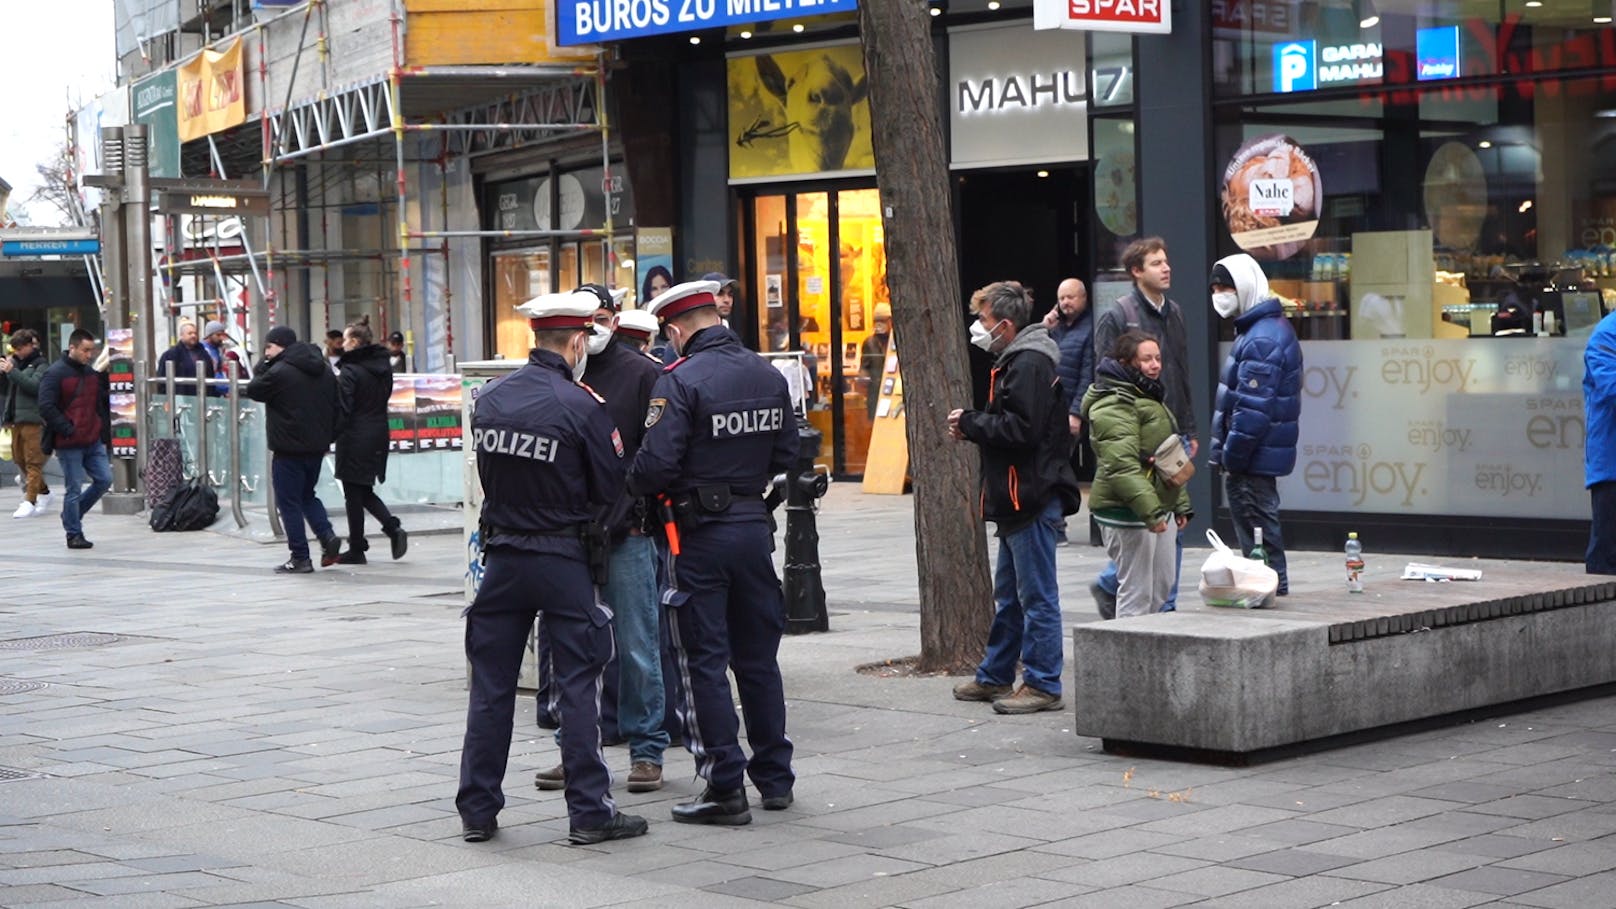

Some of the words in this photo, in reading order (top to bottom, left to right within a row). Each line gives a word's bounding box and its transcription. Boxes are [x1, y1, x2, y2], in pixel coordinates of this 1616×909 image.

[678, 0, 715, 22] ZU
[1071, 0, 1158, 17] SPAR
[1321, 43, 1383, 62] GARA
[1381, 358, 1479, 394] enjoy.
[711, 407, 783, 438] POLIZEI
[472, 427, 559, 462] POLIZEI
[1302, 444, 1354, 457] SPAR
[1408, 427, 1473, 452] enjoy.
[1303, 460, 1428, 506] enjoy.
[1475, 471, 1544, 498] enjoy.
